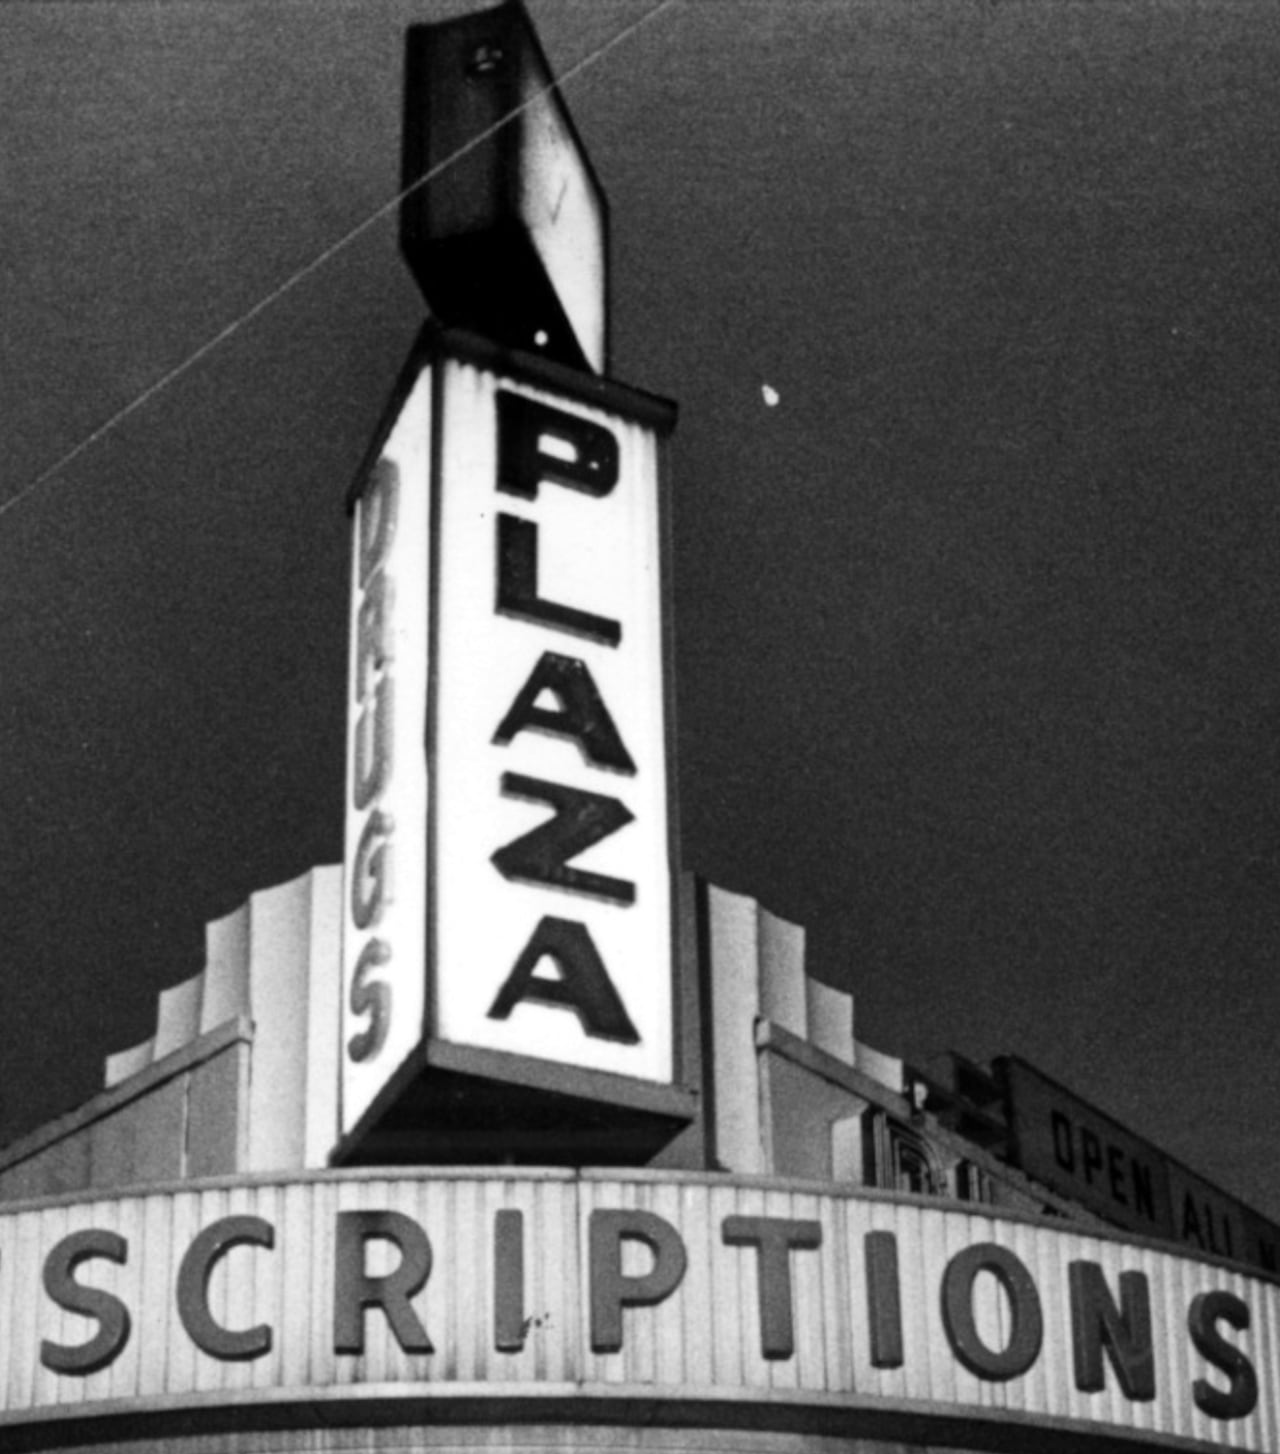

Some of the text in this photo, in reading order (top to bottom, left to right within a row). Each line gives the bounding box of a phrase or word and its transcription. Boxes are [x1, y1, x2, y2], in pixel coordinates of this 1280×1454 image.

[346, 457, 400, 1065] DRUGS
[487, 387, 642, 1047] PLAZA
[1051, 1109, 1156, 1222] OPEN
